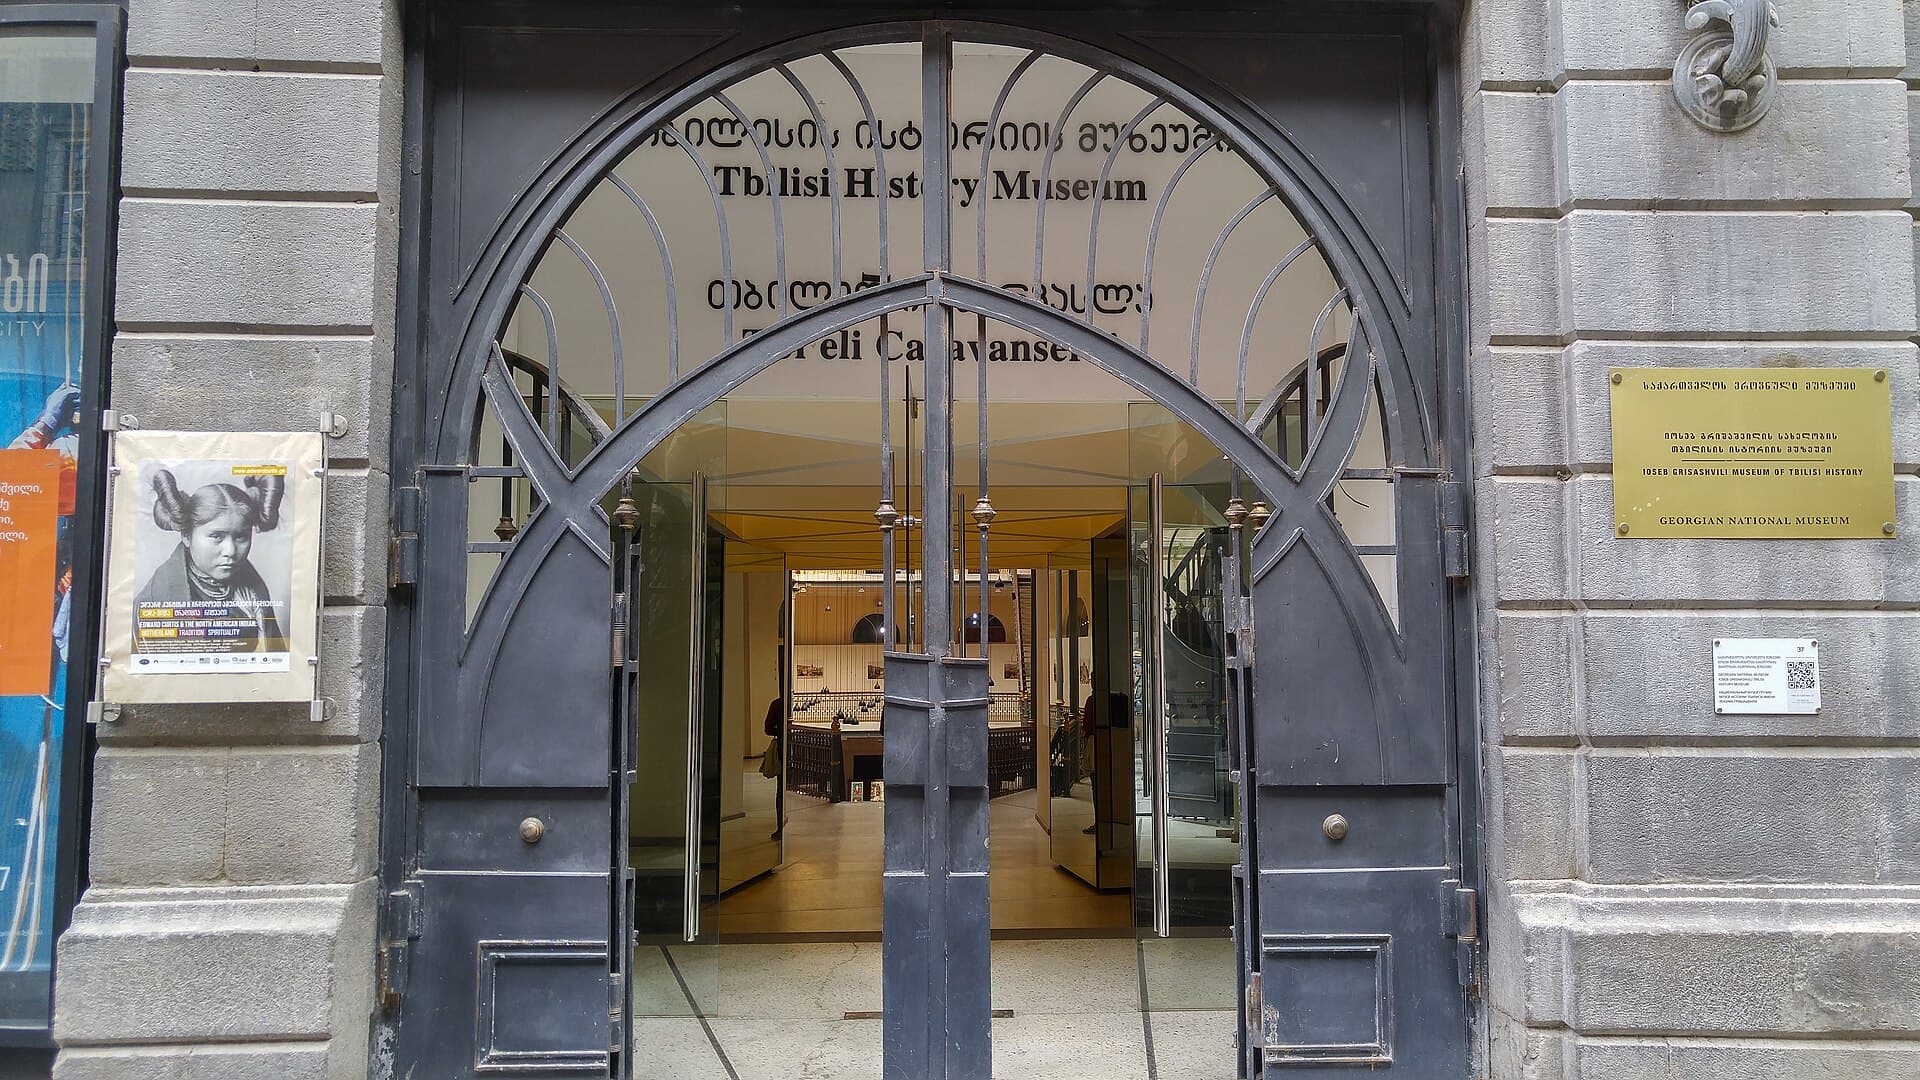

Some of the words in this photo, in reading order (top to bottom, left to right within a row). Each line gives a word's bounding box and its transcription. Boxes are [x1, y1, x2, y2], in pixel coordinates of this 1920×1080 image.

[650, 117, 839, 149] ბილისი
[856, 119, 1064, 152] ისტრიის
[1078, 122, 1232, 153] მუზეუმ
[844, 167, 980, 208] Hsty
[992, 170, 1148, 201] Museum
[876, 330, 1117, 362] Caavanse
[1642, 381, 1728, 391] საქართველოს
[1734, 381, 1798, 391] ეროვნული
[1805, 381, 1857, 391] მუზეუმი
[1664, 432, 1696, 441] იოსებ
[1700, 432, 1774, 441] გრიშაშვილის
[1778, 432, 1838, 441] სახელობის
[1671, 445, 1724, 454] თბილისის
[1729, 445, 1783, 454] ისტორიის
[1787, 445, 1833, 454] მუზეუმი
[1642, 468, 1669, 476] IOSEB
[1672, 468, 1728, 476] GRISASHVILI
[1732, 468, 1770, 476] MUSEUM
[1774, 468, 1785, 476] OF
[1789, 468, 1822, 476] TBILISI
[1825, 468, 1864, 476] HISTORY
[1659, 516, 1724, 525] GEORGIAN
[1728, 516, 1792, 525] NATIONAL
[1795, 516, 1850, 525] MUSEUM
[185, 620, 195, 628] THE
[195, 620, 212, 628] NORTH
[212, 620, 238, 628] AMERICAN
[207, 628, 240, 636] SPIRITUALITY
